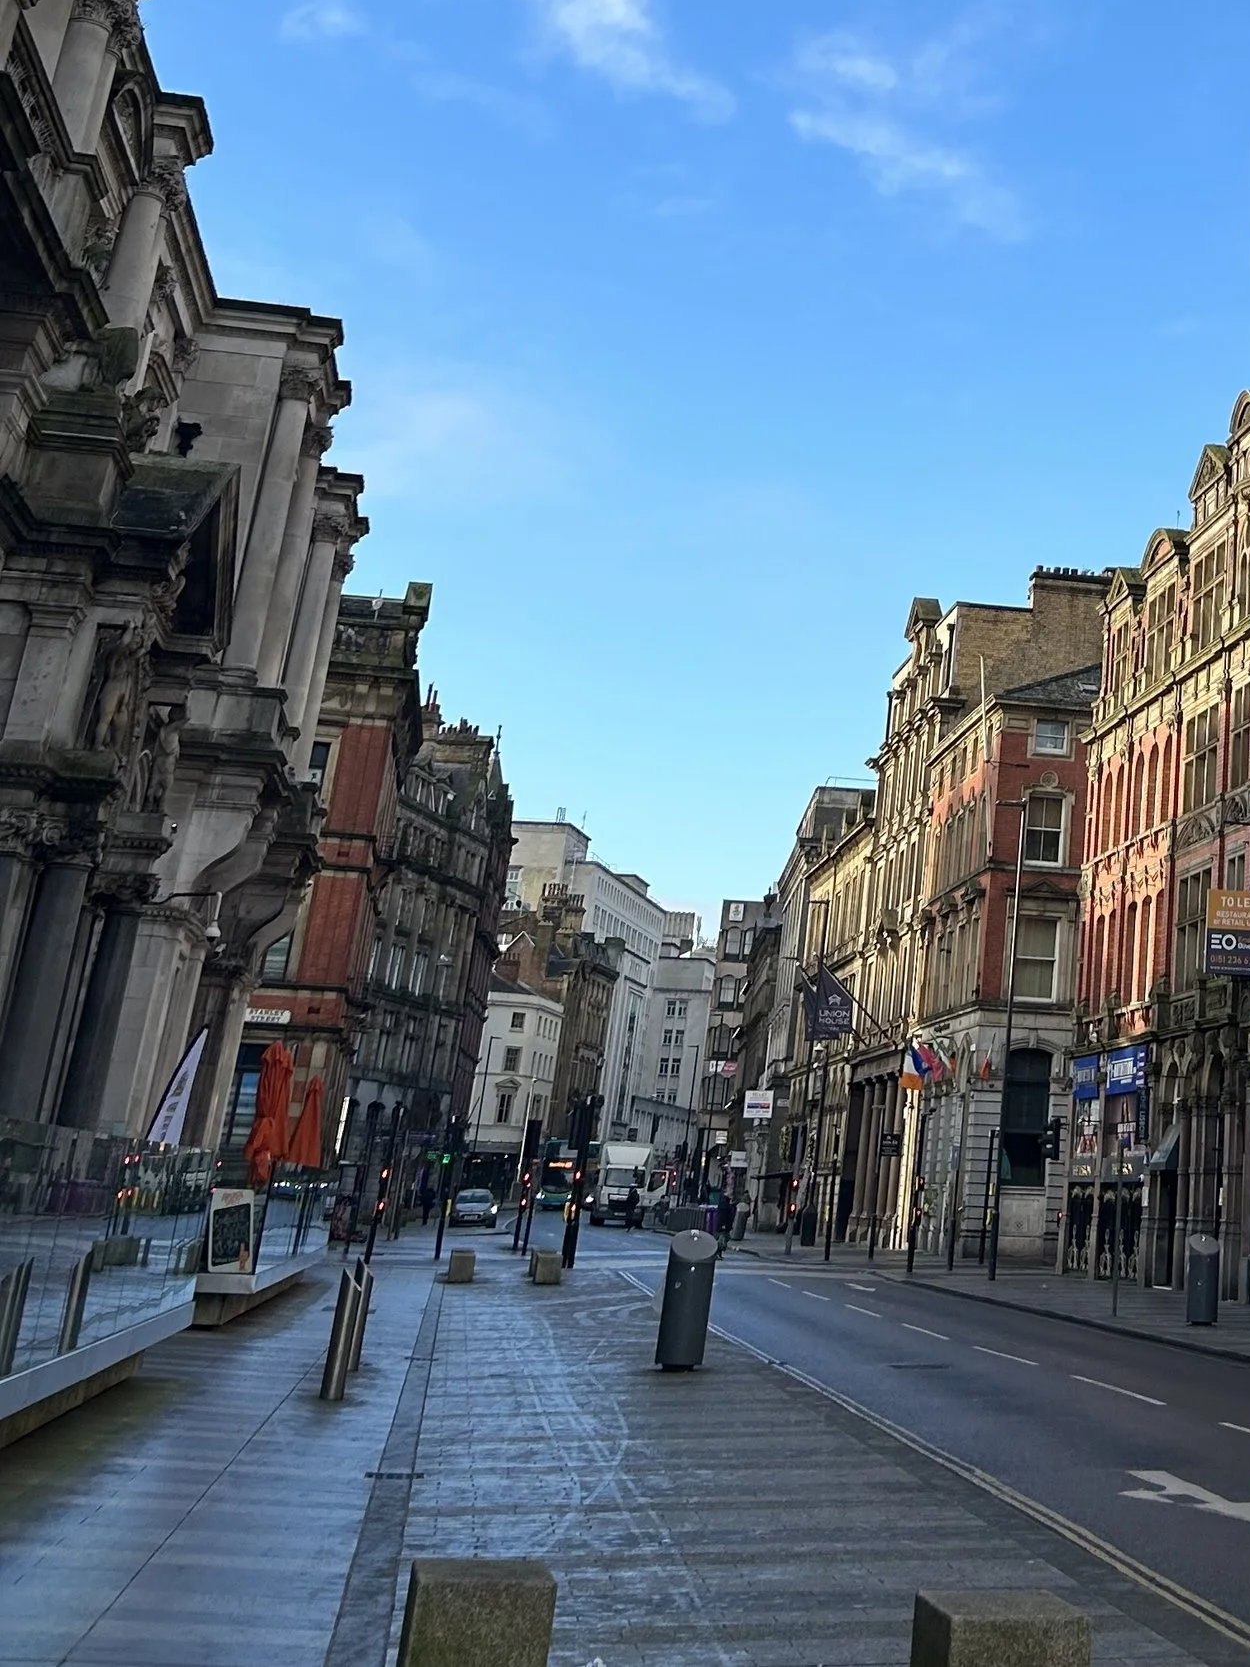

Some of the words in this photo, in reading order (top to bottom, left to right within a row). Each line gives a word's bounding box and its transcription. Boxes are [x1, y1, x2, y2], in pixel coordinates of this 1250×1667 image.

[1221, 896, 1234, 907] TO
[1221, 918, 1246, 927] RETAIL
[818, 1009, 850, 1018] UNION
[818, 1016, 850, 1025] HOUSE
